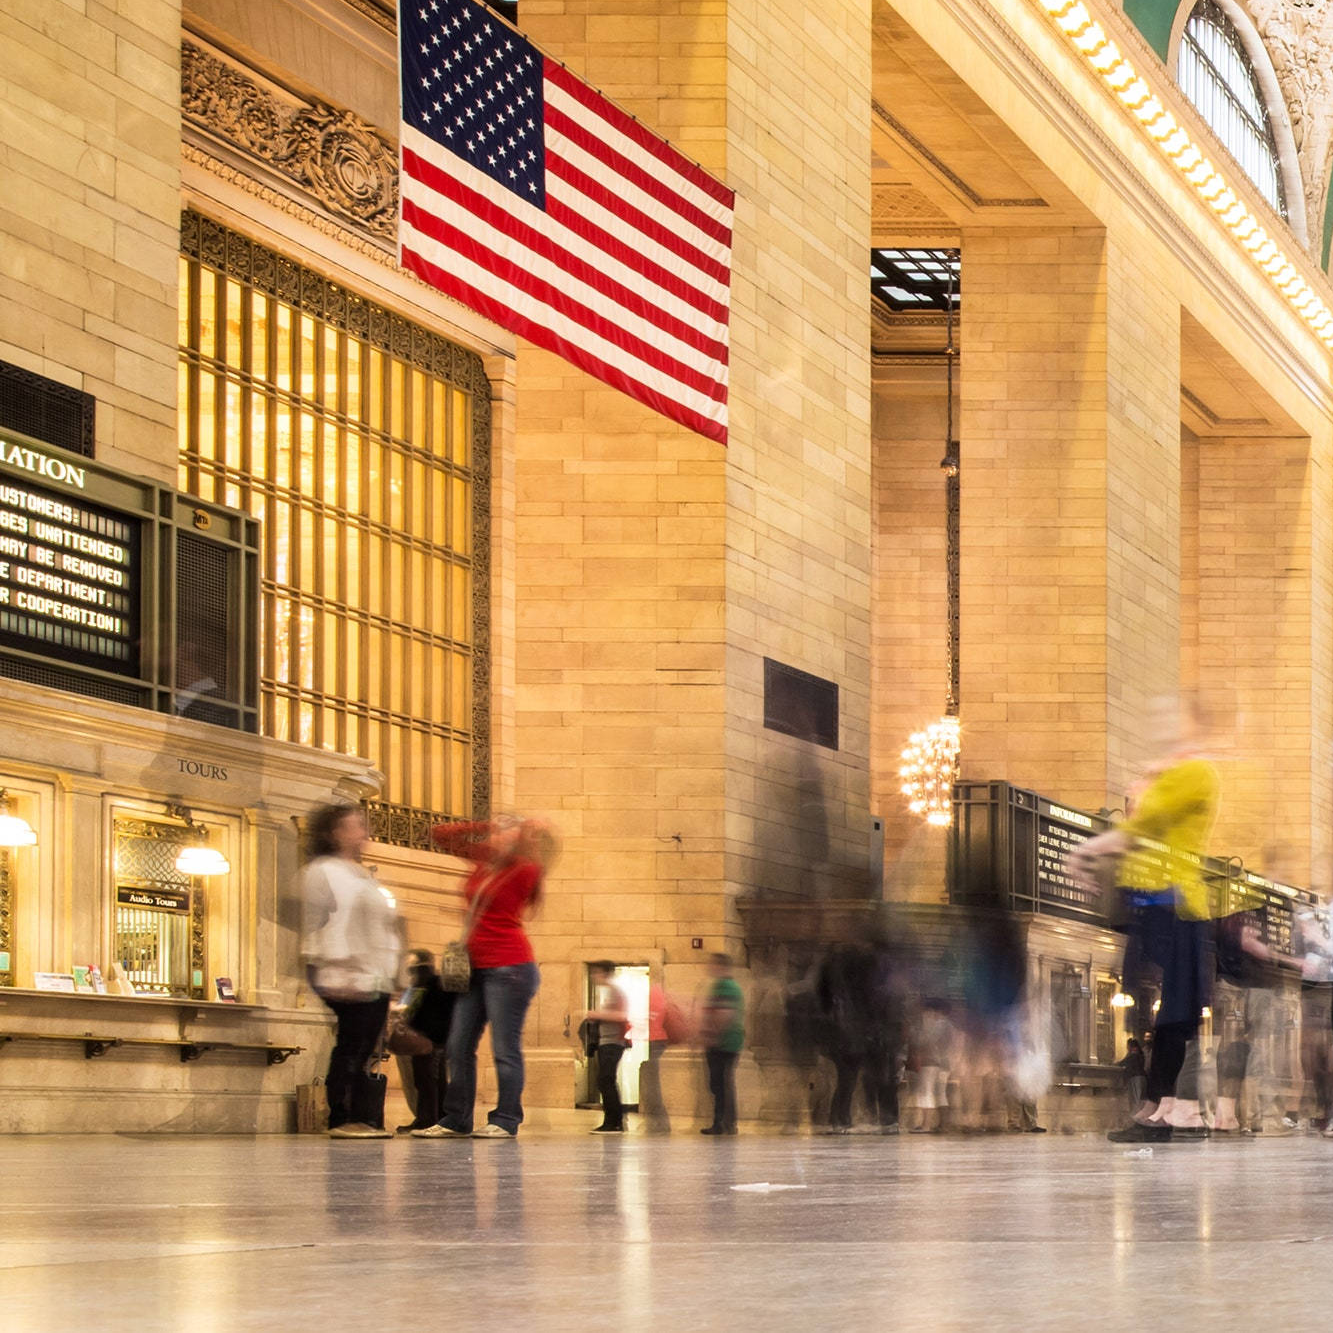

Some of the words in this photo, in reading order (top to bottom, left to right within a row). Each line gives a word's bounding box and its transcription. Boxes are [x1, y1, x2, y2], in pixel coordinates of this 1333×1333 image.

[35, 521, 123, 563] UNATTENDED
[36, 546, 55, 567] BE
[62, 554, 122, 586] REMOVED
[17, 566, 112, 607] DEPARTMENT.
[17, 591, 121, 634] COOPERATION!
[177, 758, 228, 781] TOURS
[129, 894, 154, 905] Audio
[155, 897, 178, 908] Tours
